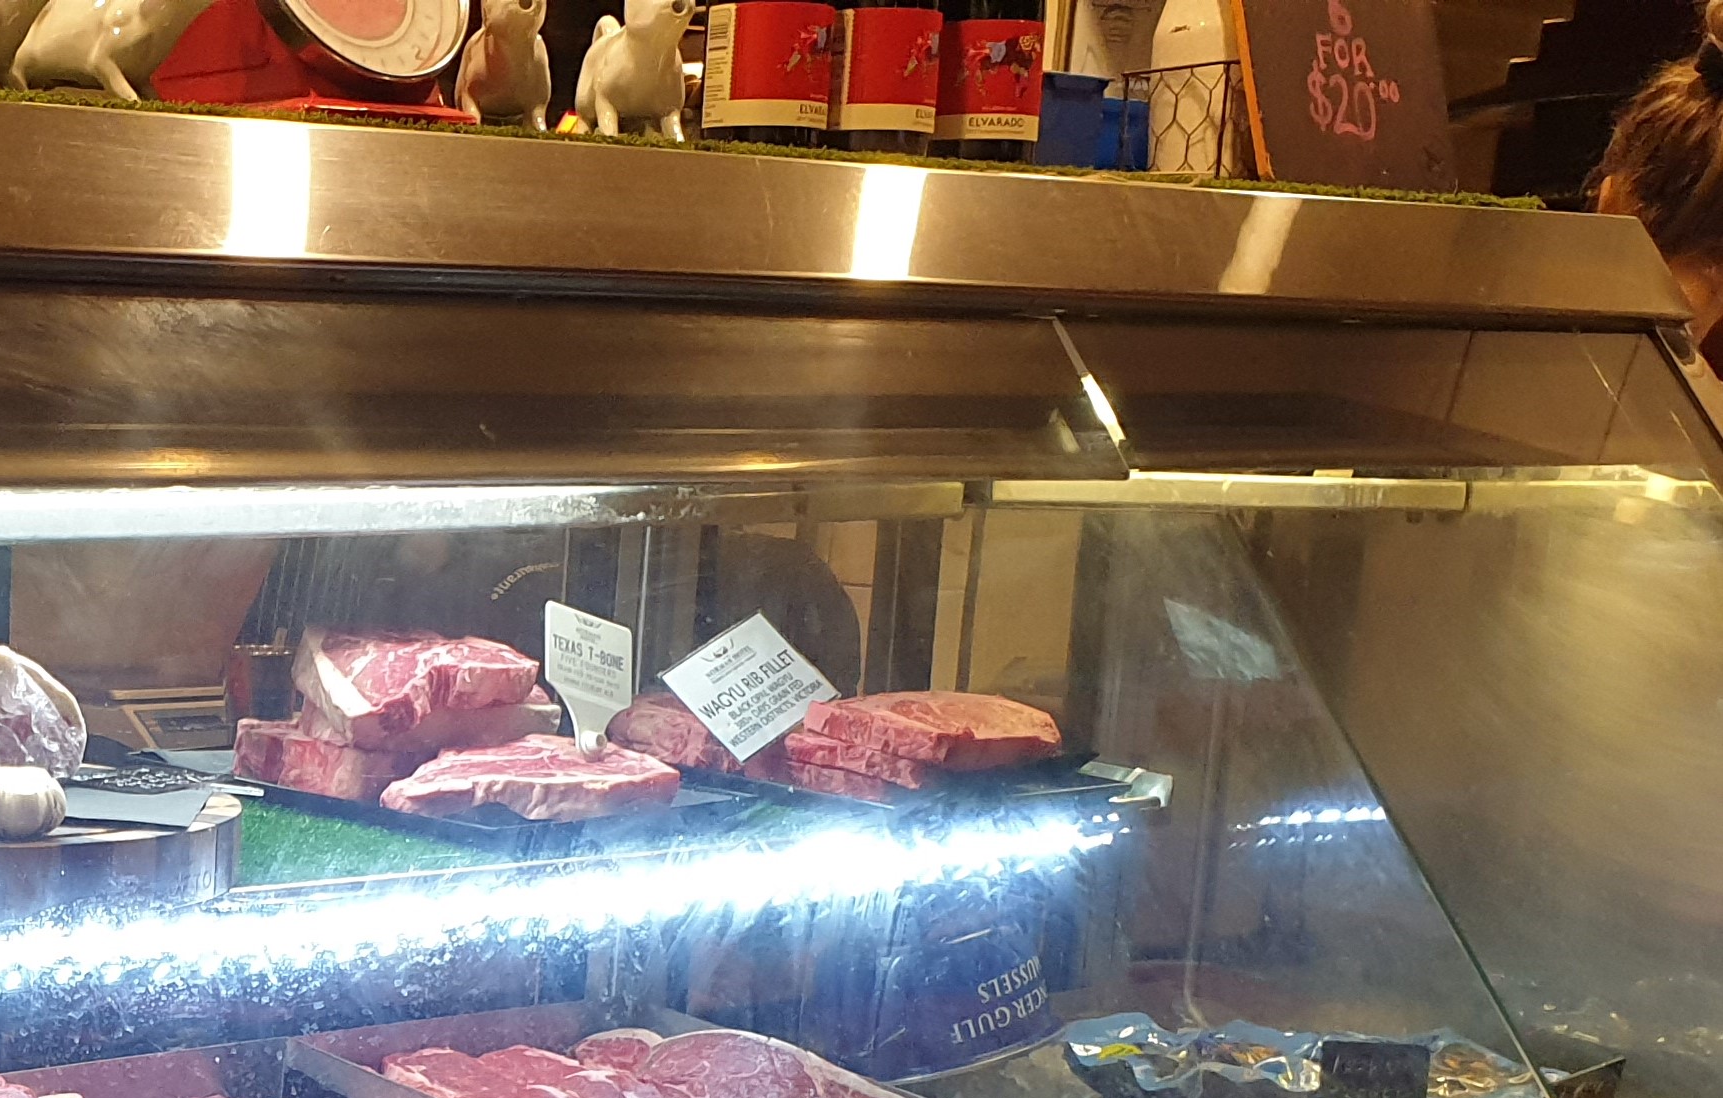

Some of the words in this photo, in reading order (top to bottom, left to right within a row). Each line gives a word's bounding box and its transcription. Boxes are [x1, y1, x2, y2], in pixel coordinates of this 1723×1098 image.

[1315, 32, 1374, 78] FOR
[968, 116, 1025, 128] ELVARADO
[552, 633, 583, 657] TEXAS
[588, 645, 624, 672] T-BONE
[698, 683, 746, 719] WAGYU
[740, 671, 764, 691] RIB
[758, 648, 795, 679] FILLET
[750, 700, 772, 718] DAYS
[951, 1005, 1010, 1044] GULF
